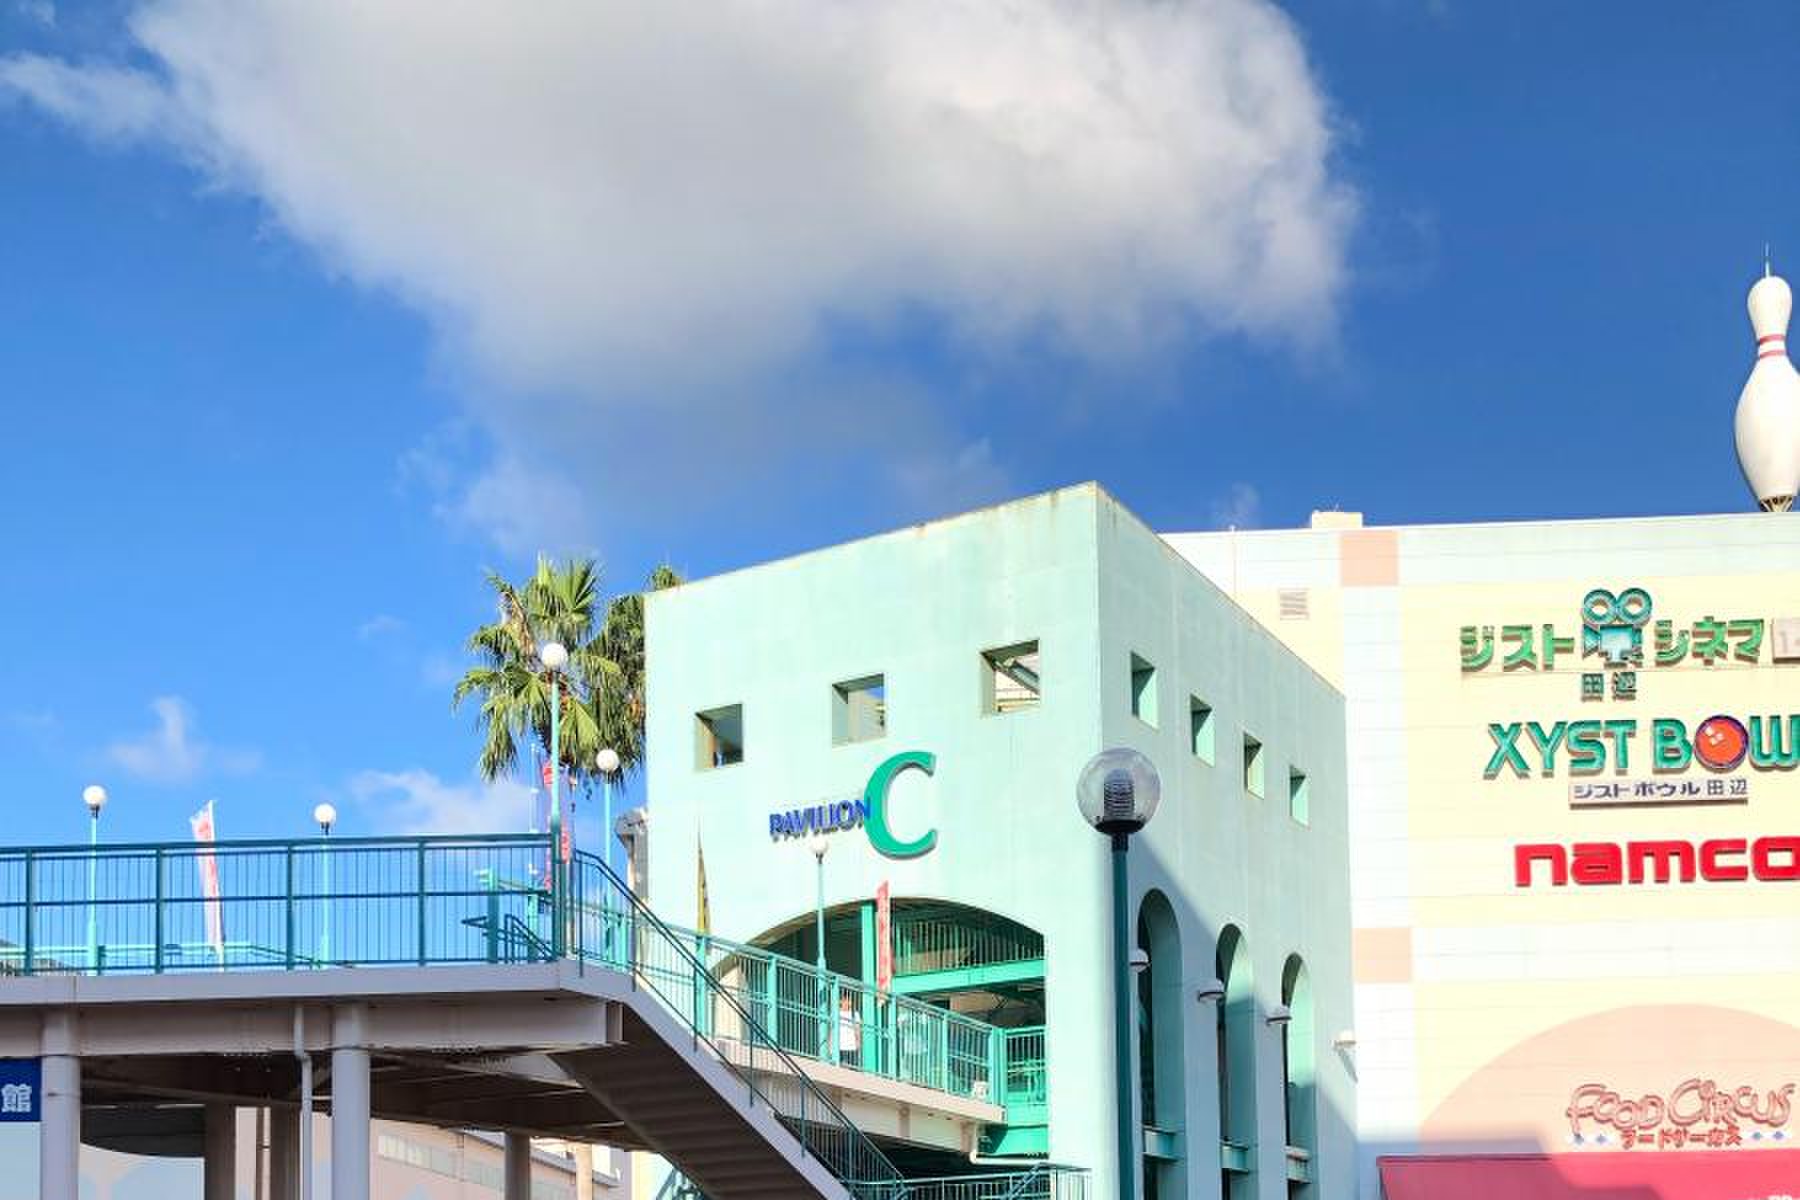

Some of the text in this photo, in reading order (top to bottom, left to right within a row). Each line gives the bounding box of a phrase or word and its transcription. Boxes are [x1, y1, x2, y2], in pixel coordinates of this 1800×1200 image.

[1460, 623, 1575, 672] ジスト
[1654, 616, 1765, 666] シネマ
[1483, 719, 1636, 779] XYST
[769, 751, 937, 861] PAVILION C
[1514, 837, 1800, 887] namco
[1, 1083, 33, 1113] 館
